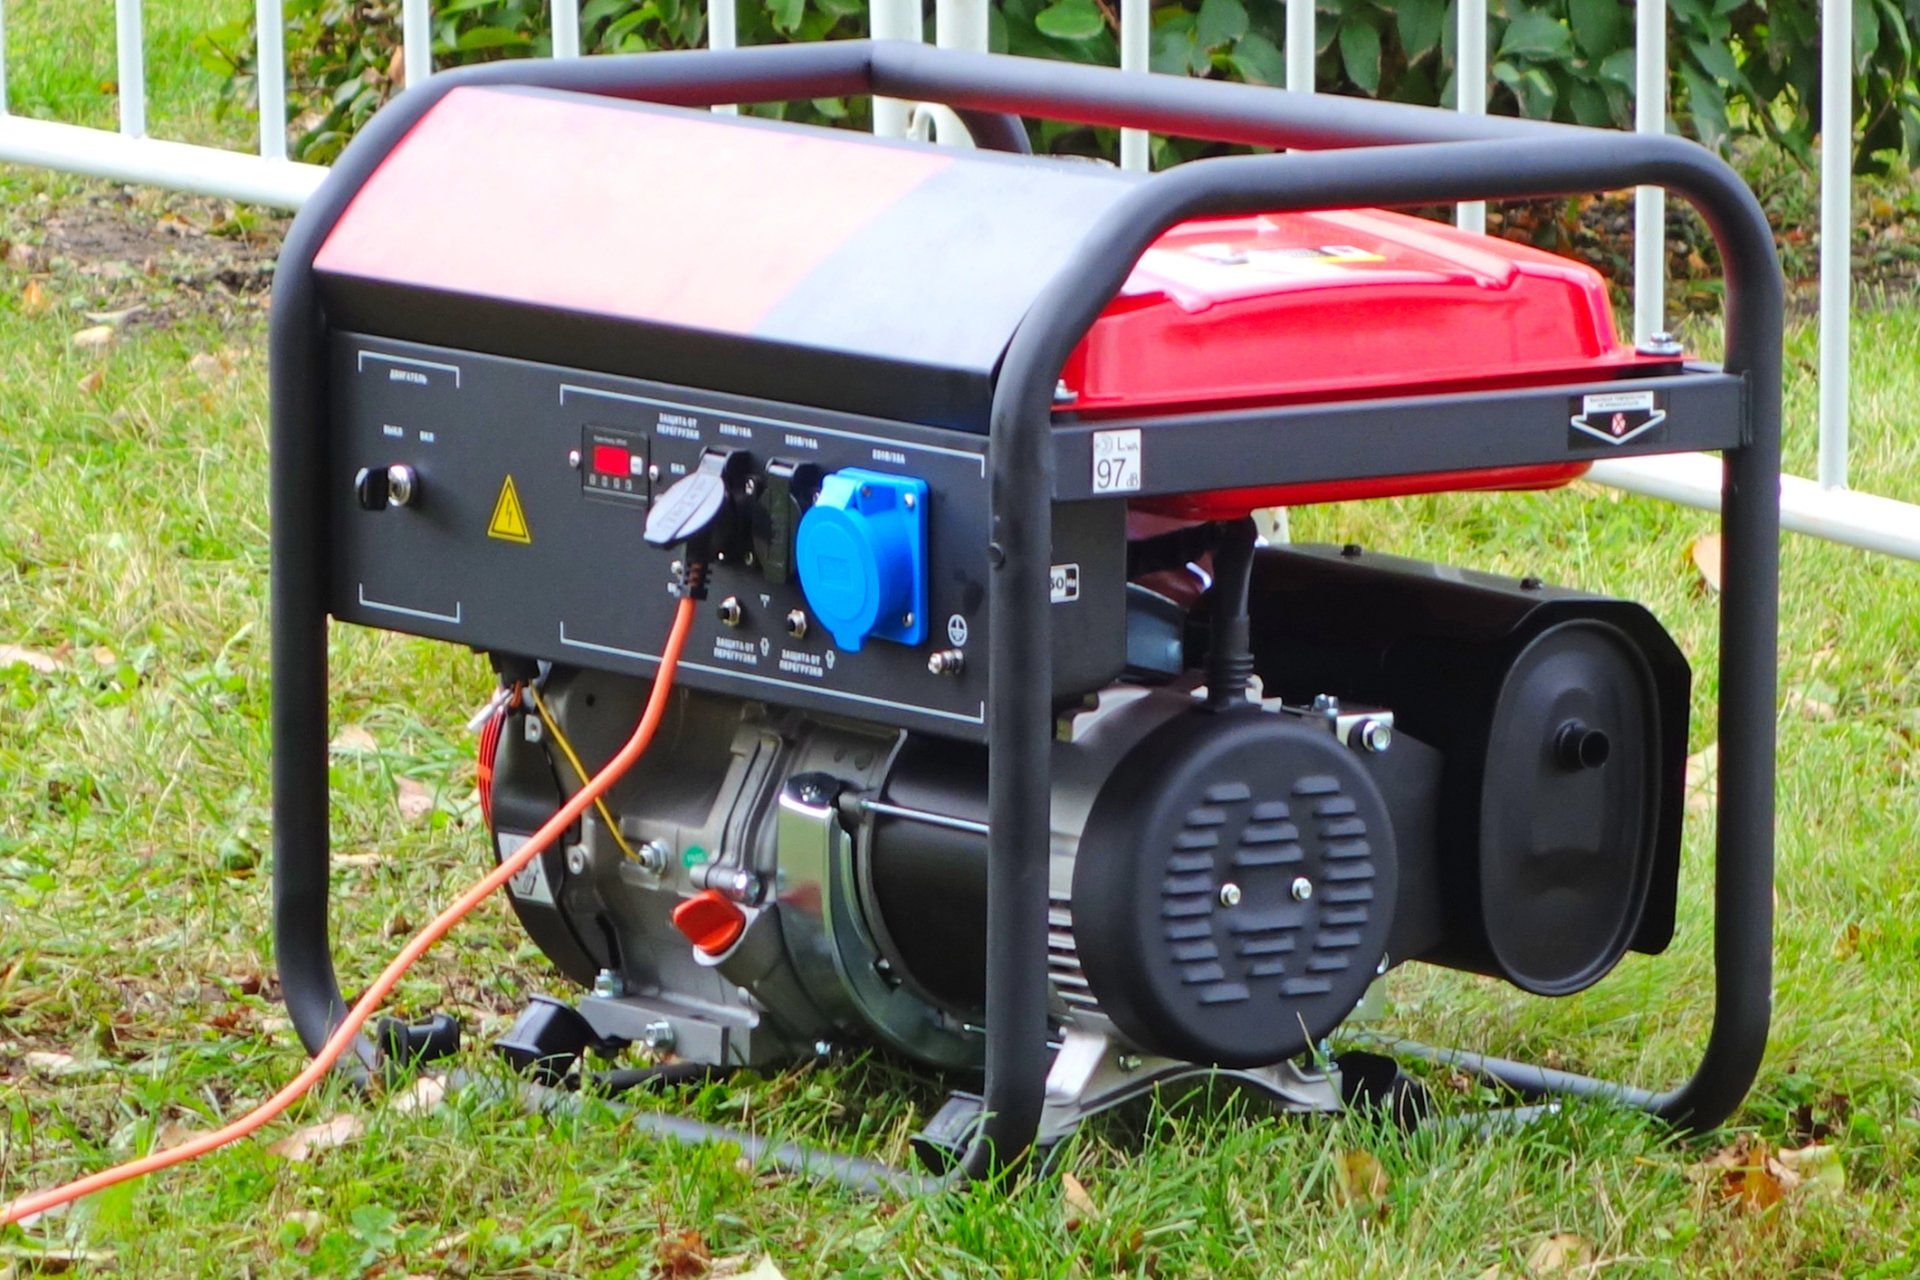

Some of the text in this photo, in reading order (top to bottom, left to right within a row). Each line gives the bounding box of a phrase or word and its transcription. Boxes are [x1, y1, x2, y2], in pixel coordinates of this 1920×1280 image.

[659, 412, 698, 429] ЗАЩИТА ОТ
[656, 423, 700, 440] ПЕРЕГРУЗКИ
[1097, 457, 1126, 489] 97
[716, 636, 755, 653] ЗАЩИТА ОТ
[714, 647, 757, 665] ПЕРЕГРУЗКИ
[781, 648, 821, 666] ЗАЩИТА ОТ
[779, 660, 823, 677] ПЕРЕГРУЗКИ
